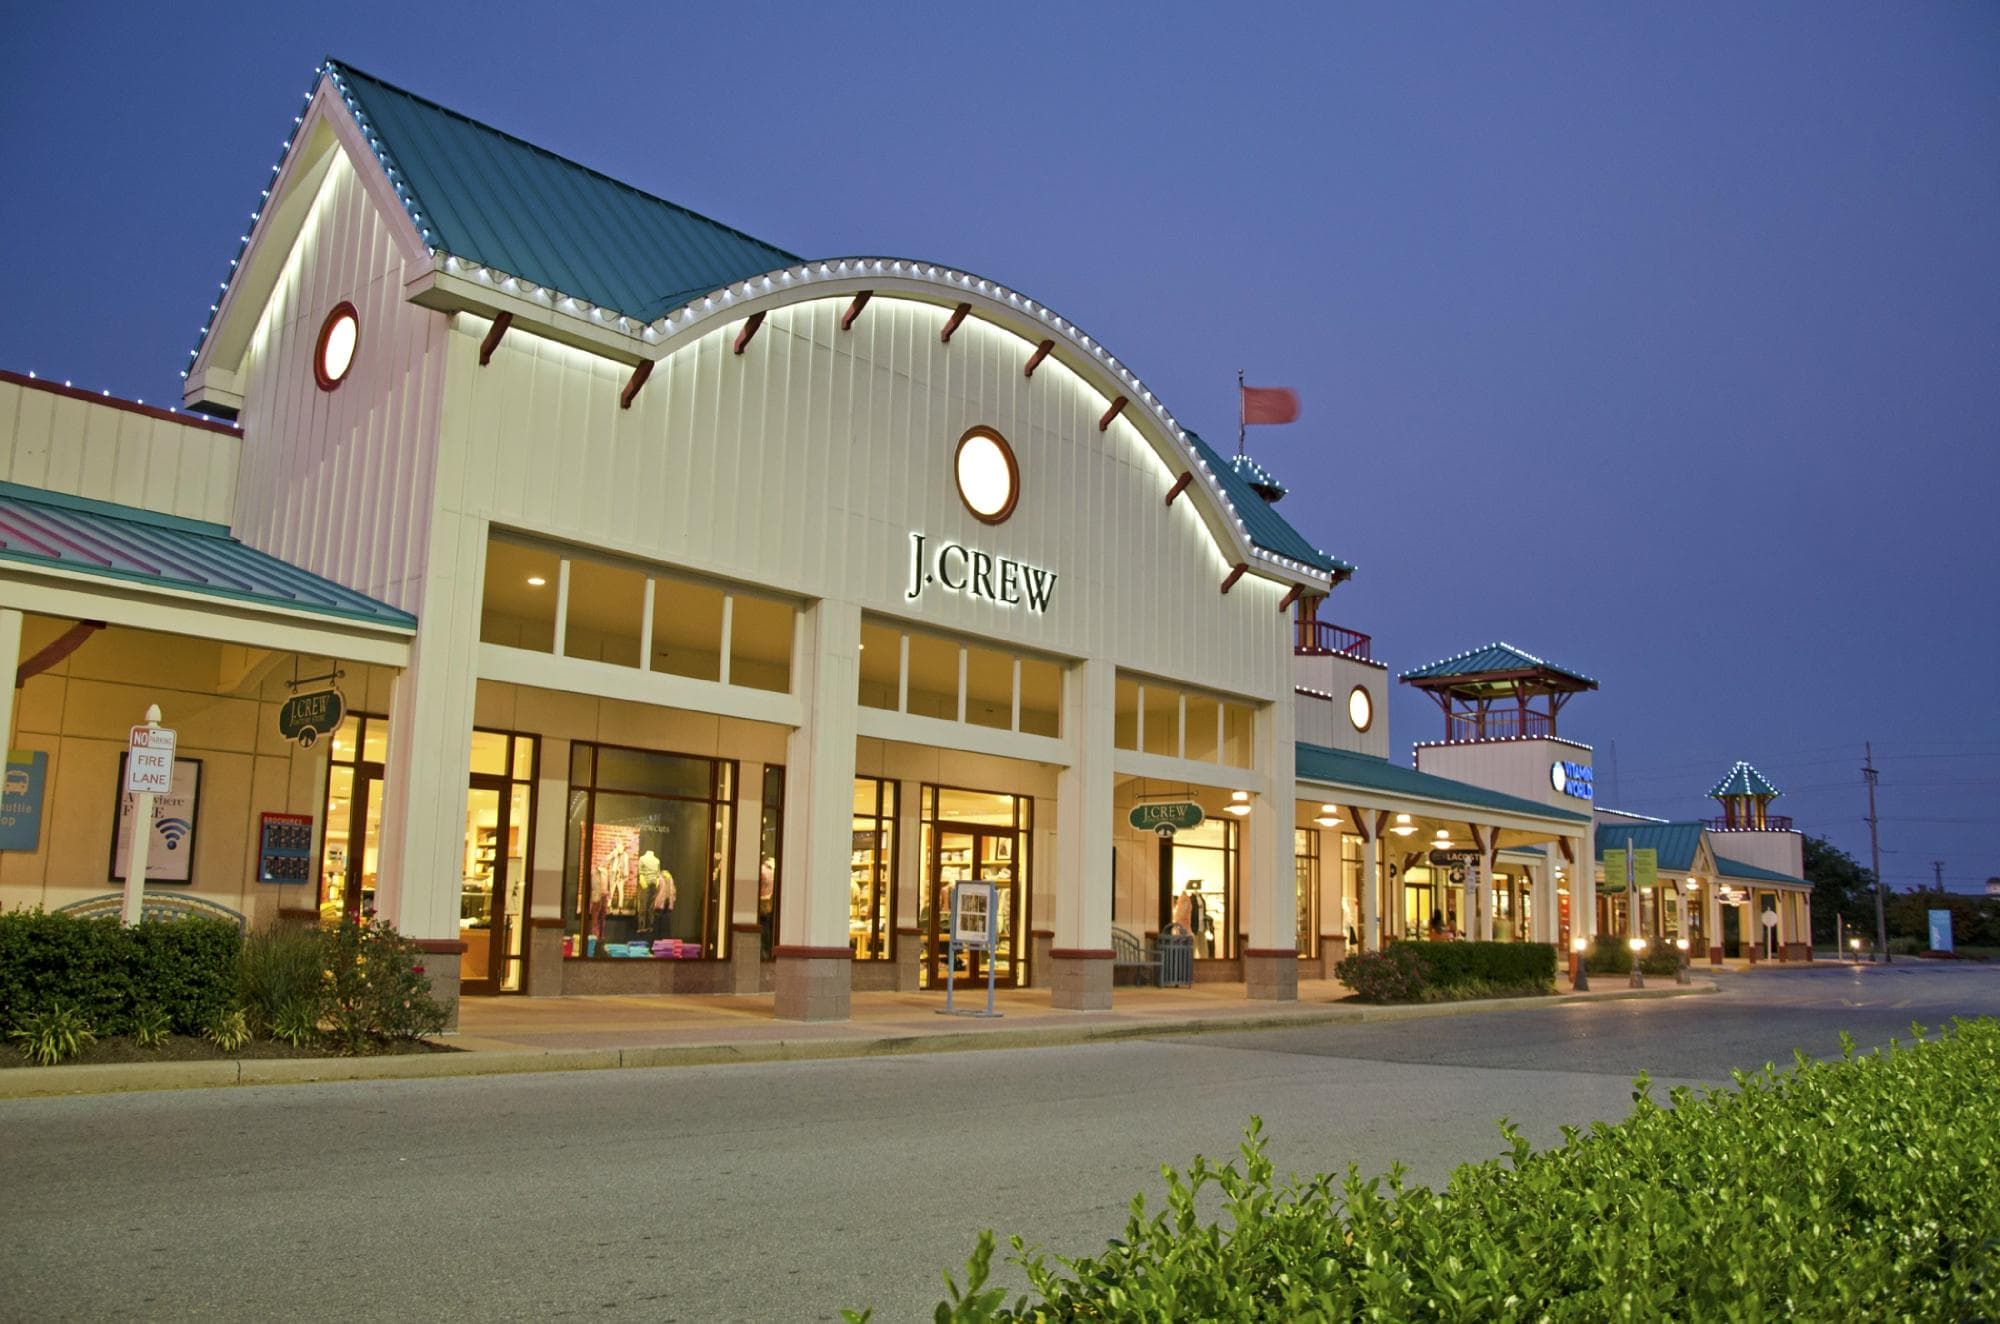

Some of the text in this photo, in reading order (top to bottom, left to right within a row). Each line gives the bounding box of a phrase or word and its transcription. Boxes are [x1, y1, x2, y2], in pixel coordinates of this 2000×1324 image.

[908, 534, 1058, 613] J.CREW
[289, 695, 330, 728] J.CREW
[133, 731, 149, 746] NO
[138, 755, 166, 767] FIRE
[1565, 760, 1593, 781] VITAMIN
[133, 773, 167, 785] LANE
[1566, 780, 1593, 800] WORLD
[1143, 806, 1188, 824] J.CREW
